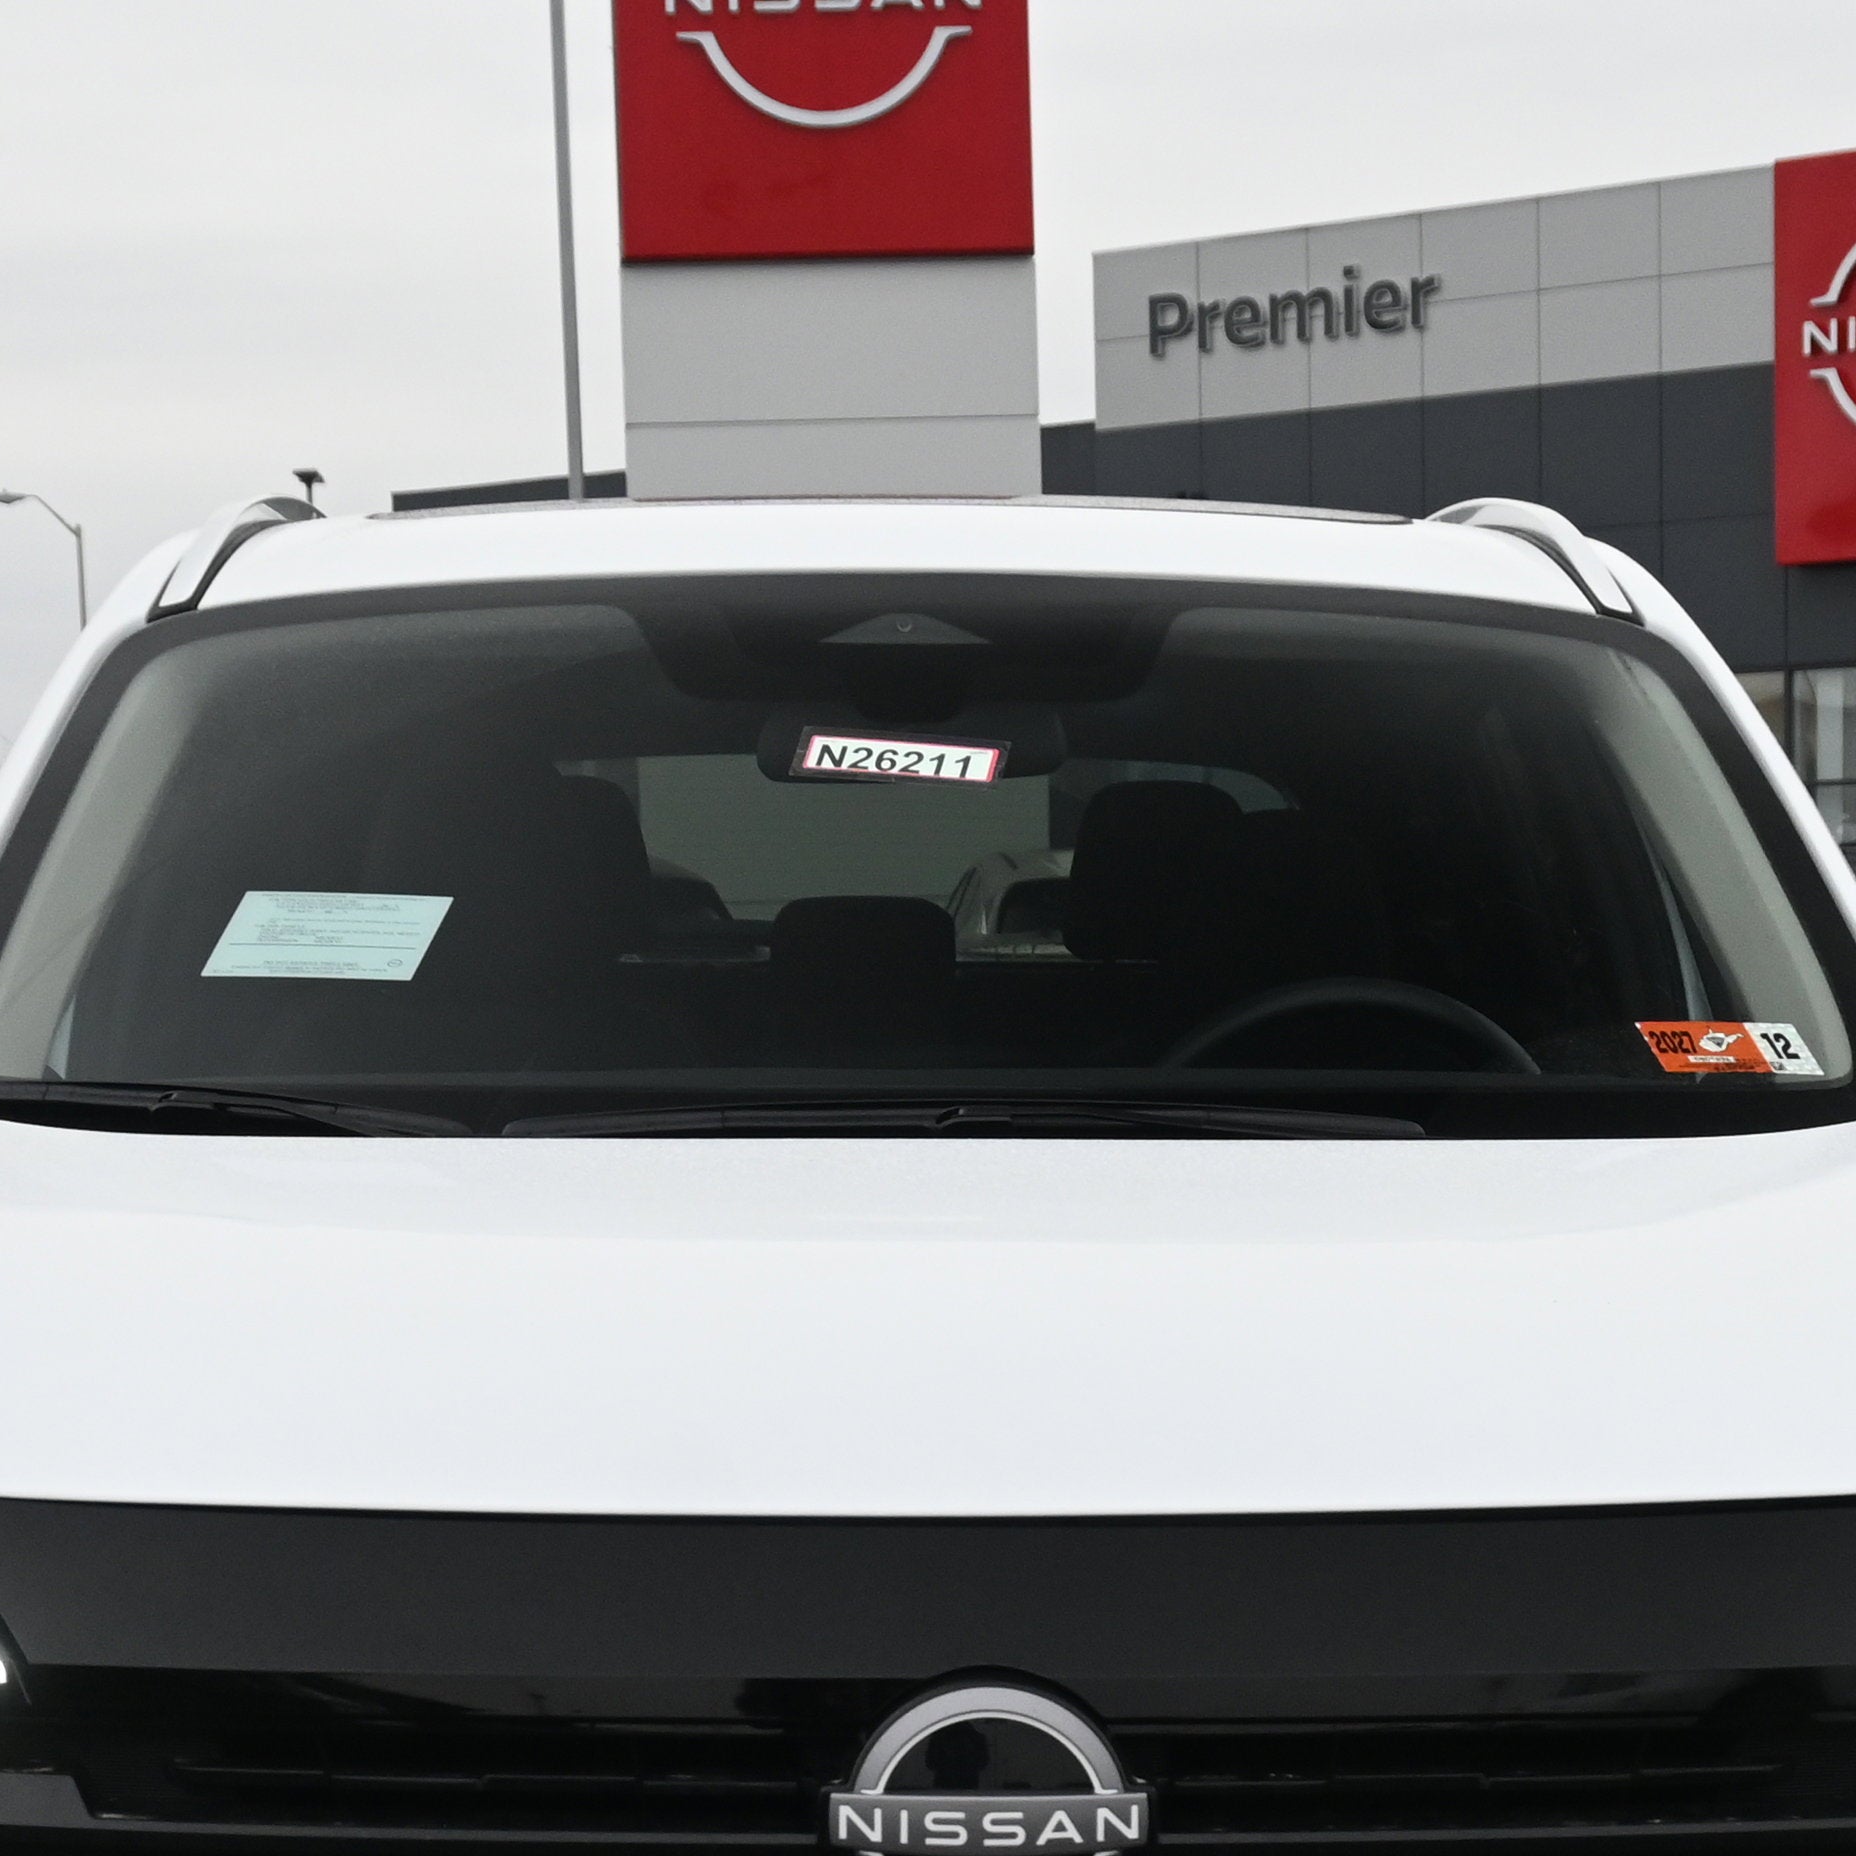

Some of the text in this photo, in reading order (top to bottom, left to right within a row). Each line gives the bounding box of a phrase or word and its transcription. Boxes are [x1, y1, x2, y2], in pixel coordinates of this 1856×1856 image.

[1148, 264, 1441, 361] Premier
[815, 743, 973, 780] N26211
[1649, 1031, 1802, 1060] 2027 12
[839, 1804, 1140, 1847] NISSAN
